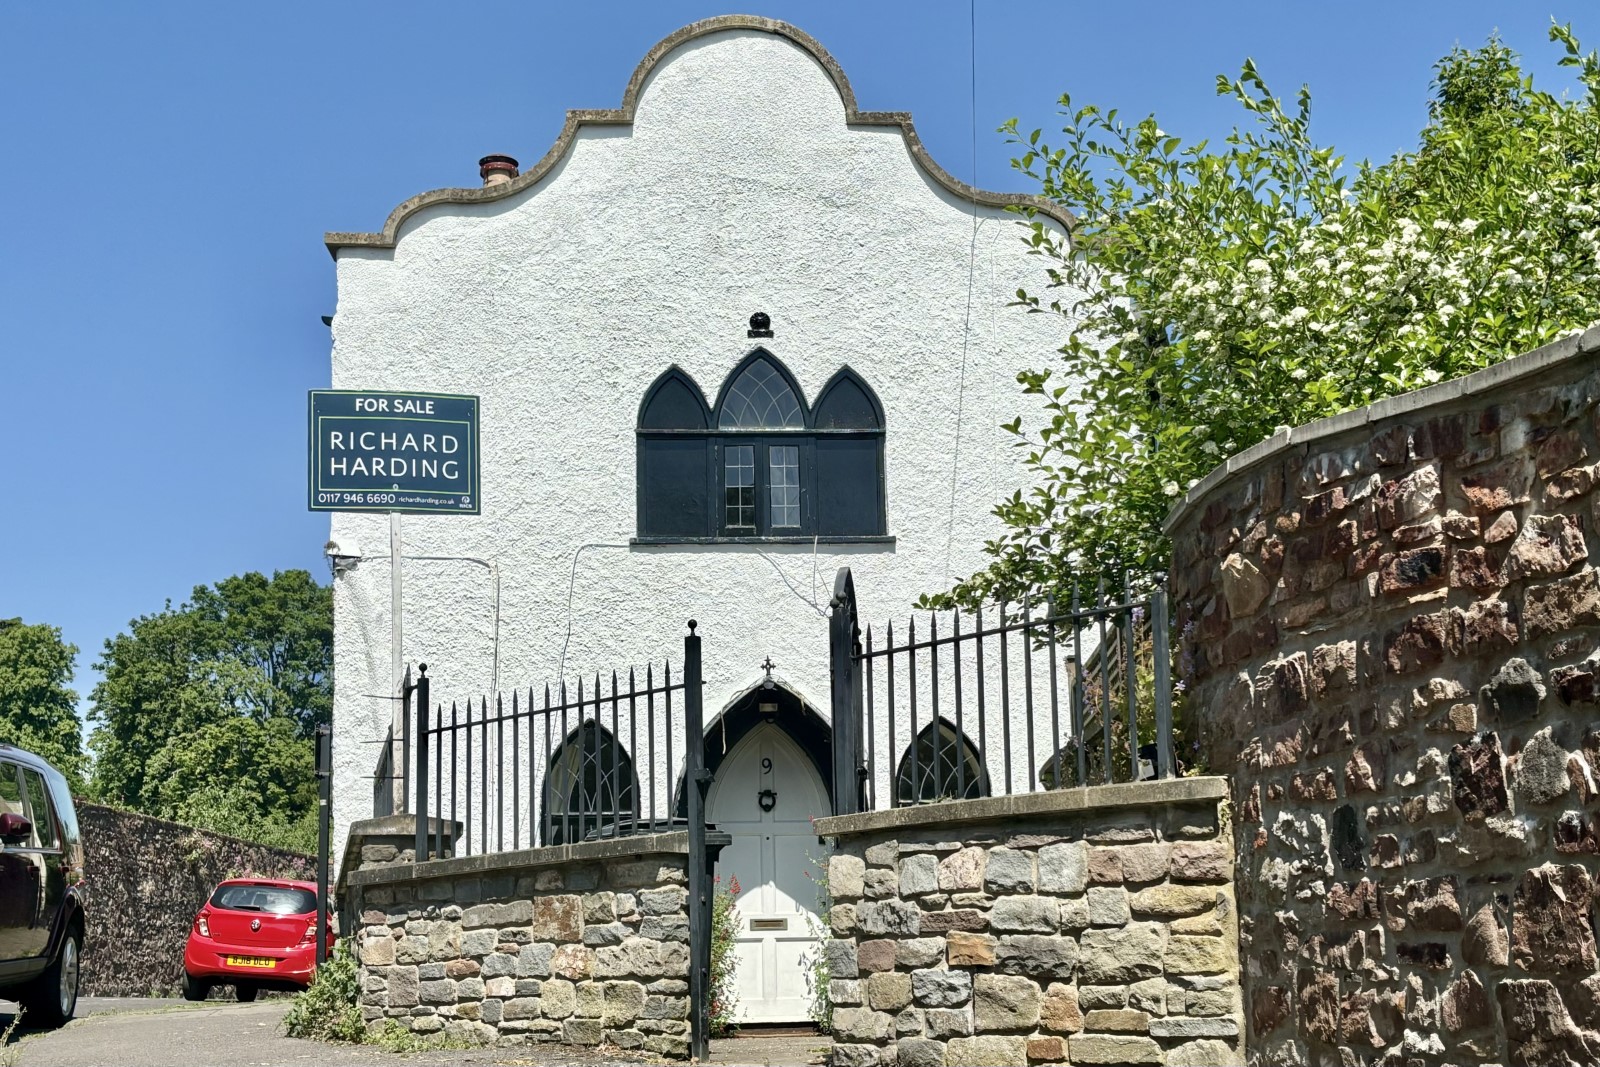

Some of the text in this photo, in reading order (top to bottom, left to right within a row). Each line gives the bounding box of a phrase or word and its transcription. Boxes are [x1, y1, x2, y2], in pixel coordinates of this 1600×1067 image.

[355, 398, 434, 414] FOR SALE
[331, 431, 458, 454] RICHARD
[331, 457, 458, 479] HARDING
[318, 493, 455, 505] 0117 946 6690 richardharding.co.uk
[761, 757, 772, 774] 9
